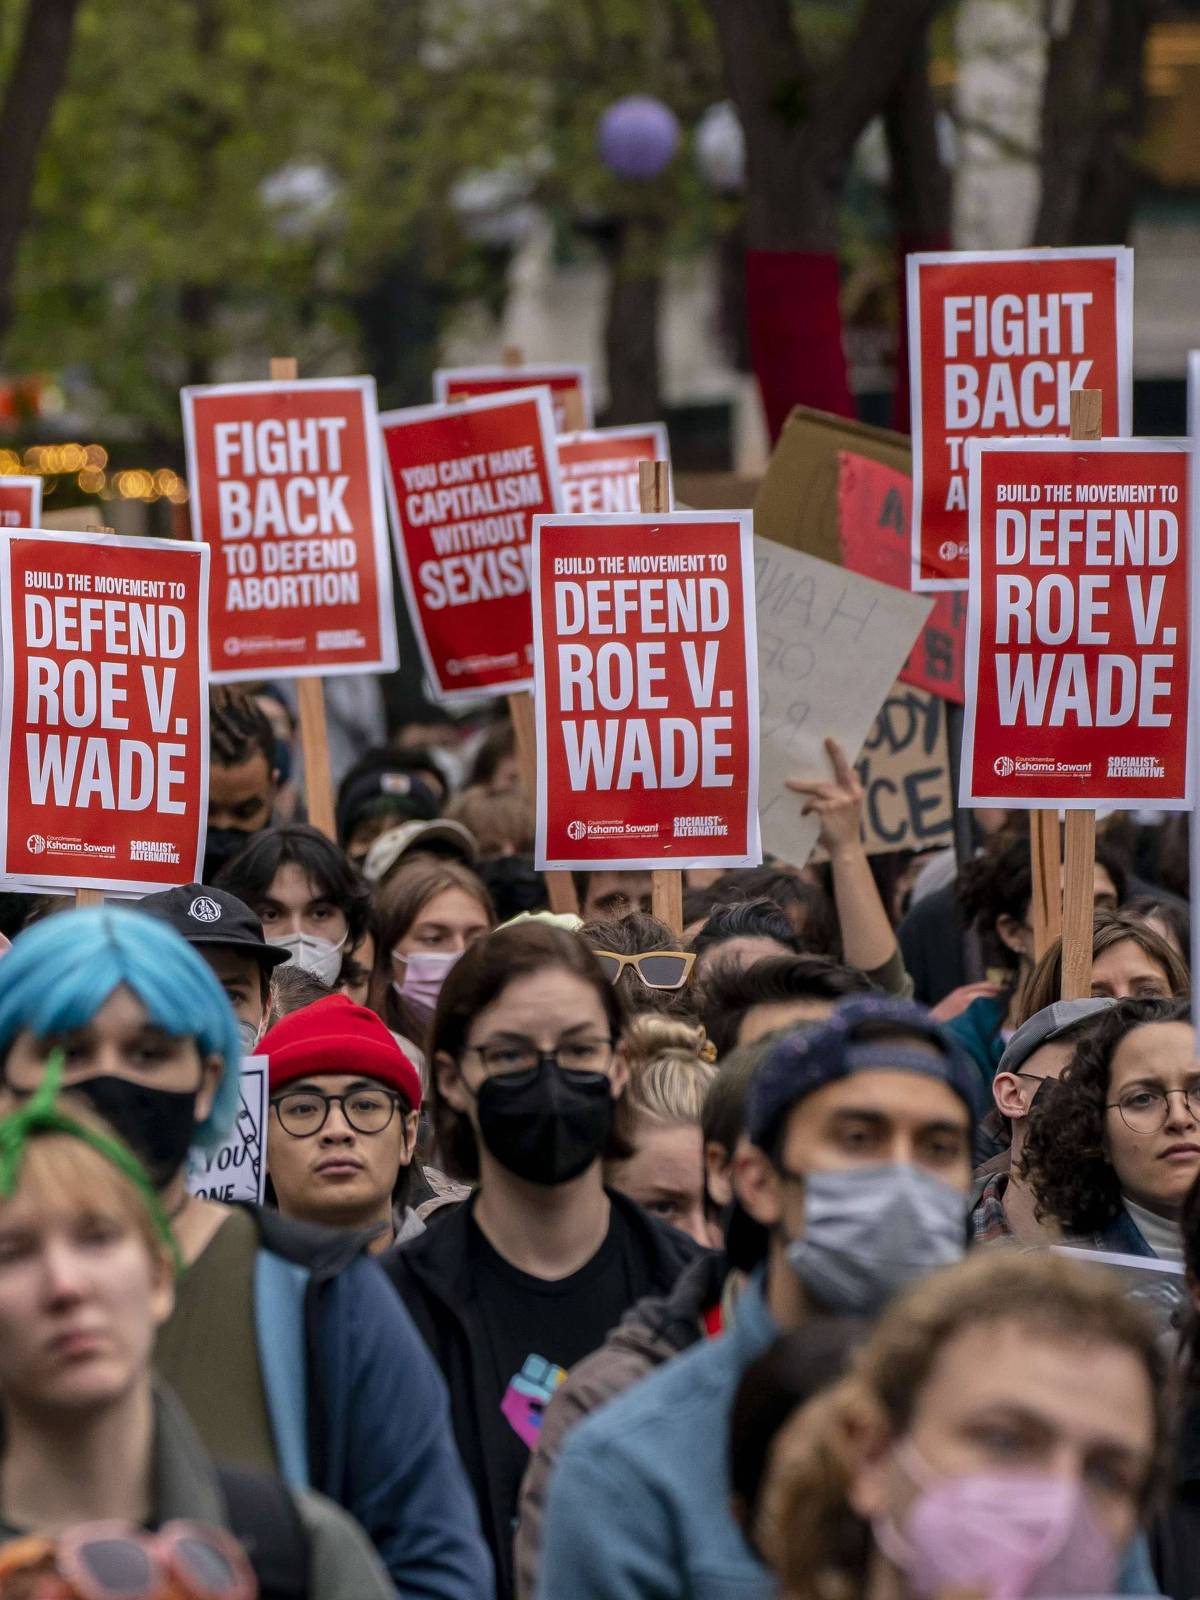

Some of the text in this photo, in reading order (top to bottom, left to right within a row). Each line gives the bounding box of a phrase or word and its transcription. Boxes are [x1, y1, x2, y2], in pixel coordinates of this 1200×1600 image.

[944, 292, 1093, 358] FIGHT
[213, 416, 348, 477] FIGHT
[401, 464, 438, 491] YOU
[488, 446, 537, 477] HAVE
[217, 476, 354, 541] BACK
[405, 473, 544, 528] CAPITALISM
[997, 484, 1178, 503] BUILD THE MOVEMENT TO
[430, 512, 526, 556] WITHOUT
[996, 509, 1179, 566] DEFEND
[221, 538, 358, 575] TO DEFEND
[554, 554, 727, 575] BUILD THE MOVEMENT TO
[25, 571, 185, 600] BUILD THE MOVEMENT TO
[225, 571, 360, 612] ABORTION
[554, 578, 730, 636] DEFEND
[25, 594, 186, 660] DEFEND
[995, 573, 1110, 646] ROE
[1126, 574, 1177, 645] V.
[26, 656, 188, 735] ROE V.
[557, 640, 734, 712] ROE V.
[994, 653, 1174, 728] WADE
[25, 732, 187, 815] WADE
[561, 716, 734, 792] WADE
[1015, 762, 1092, 772] Kshama Sawant
[1107, 767, 1165, 777] ALTERNATIVE
[1108, 756, 1155, 767] SOCIALIST
[588, 823, 659, 833] Kshama Sawant
[673, 816, 718, 827] SOCIALIST
[673, 825, 728, 836] ALTERNATIVE
[47, 841, 116, 853] Kshama Sawant
[130, 840, 172, 853] SOCIALIST
[130, 850, 180, 864] ALTERNATIVE
